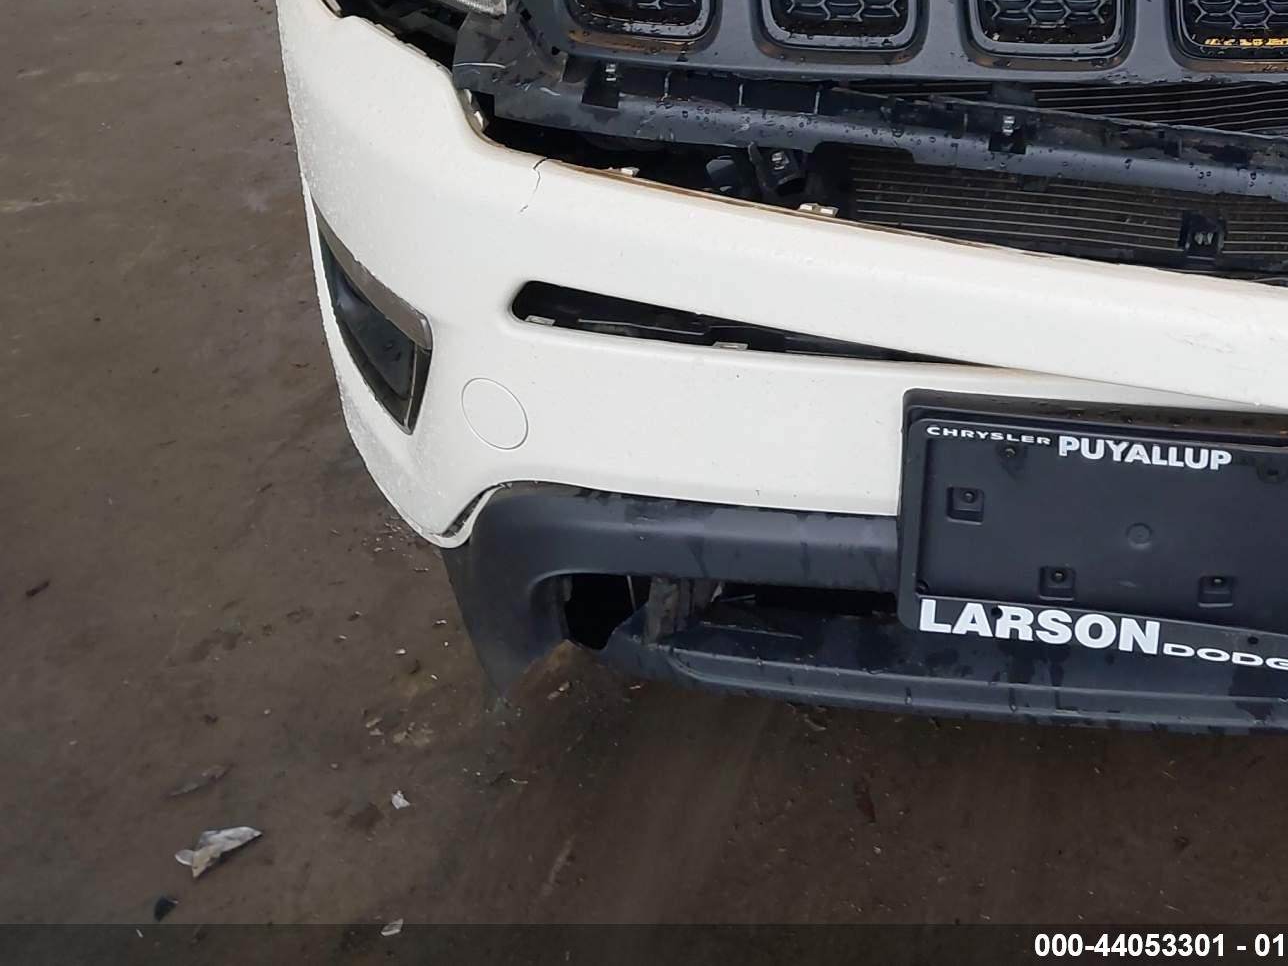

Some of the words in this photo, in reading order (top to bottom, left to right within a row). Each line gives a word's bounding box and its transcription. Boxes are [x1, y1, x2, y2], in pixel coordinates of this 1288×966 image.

[926, 426, 1052, 445] CHRYSLER
[1058, 435, 1232, 470] PUYALLUP
[918, 598, 1161, 656] LARSON
